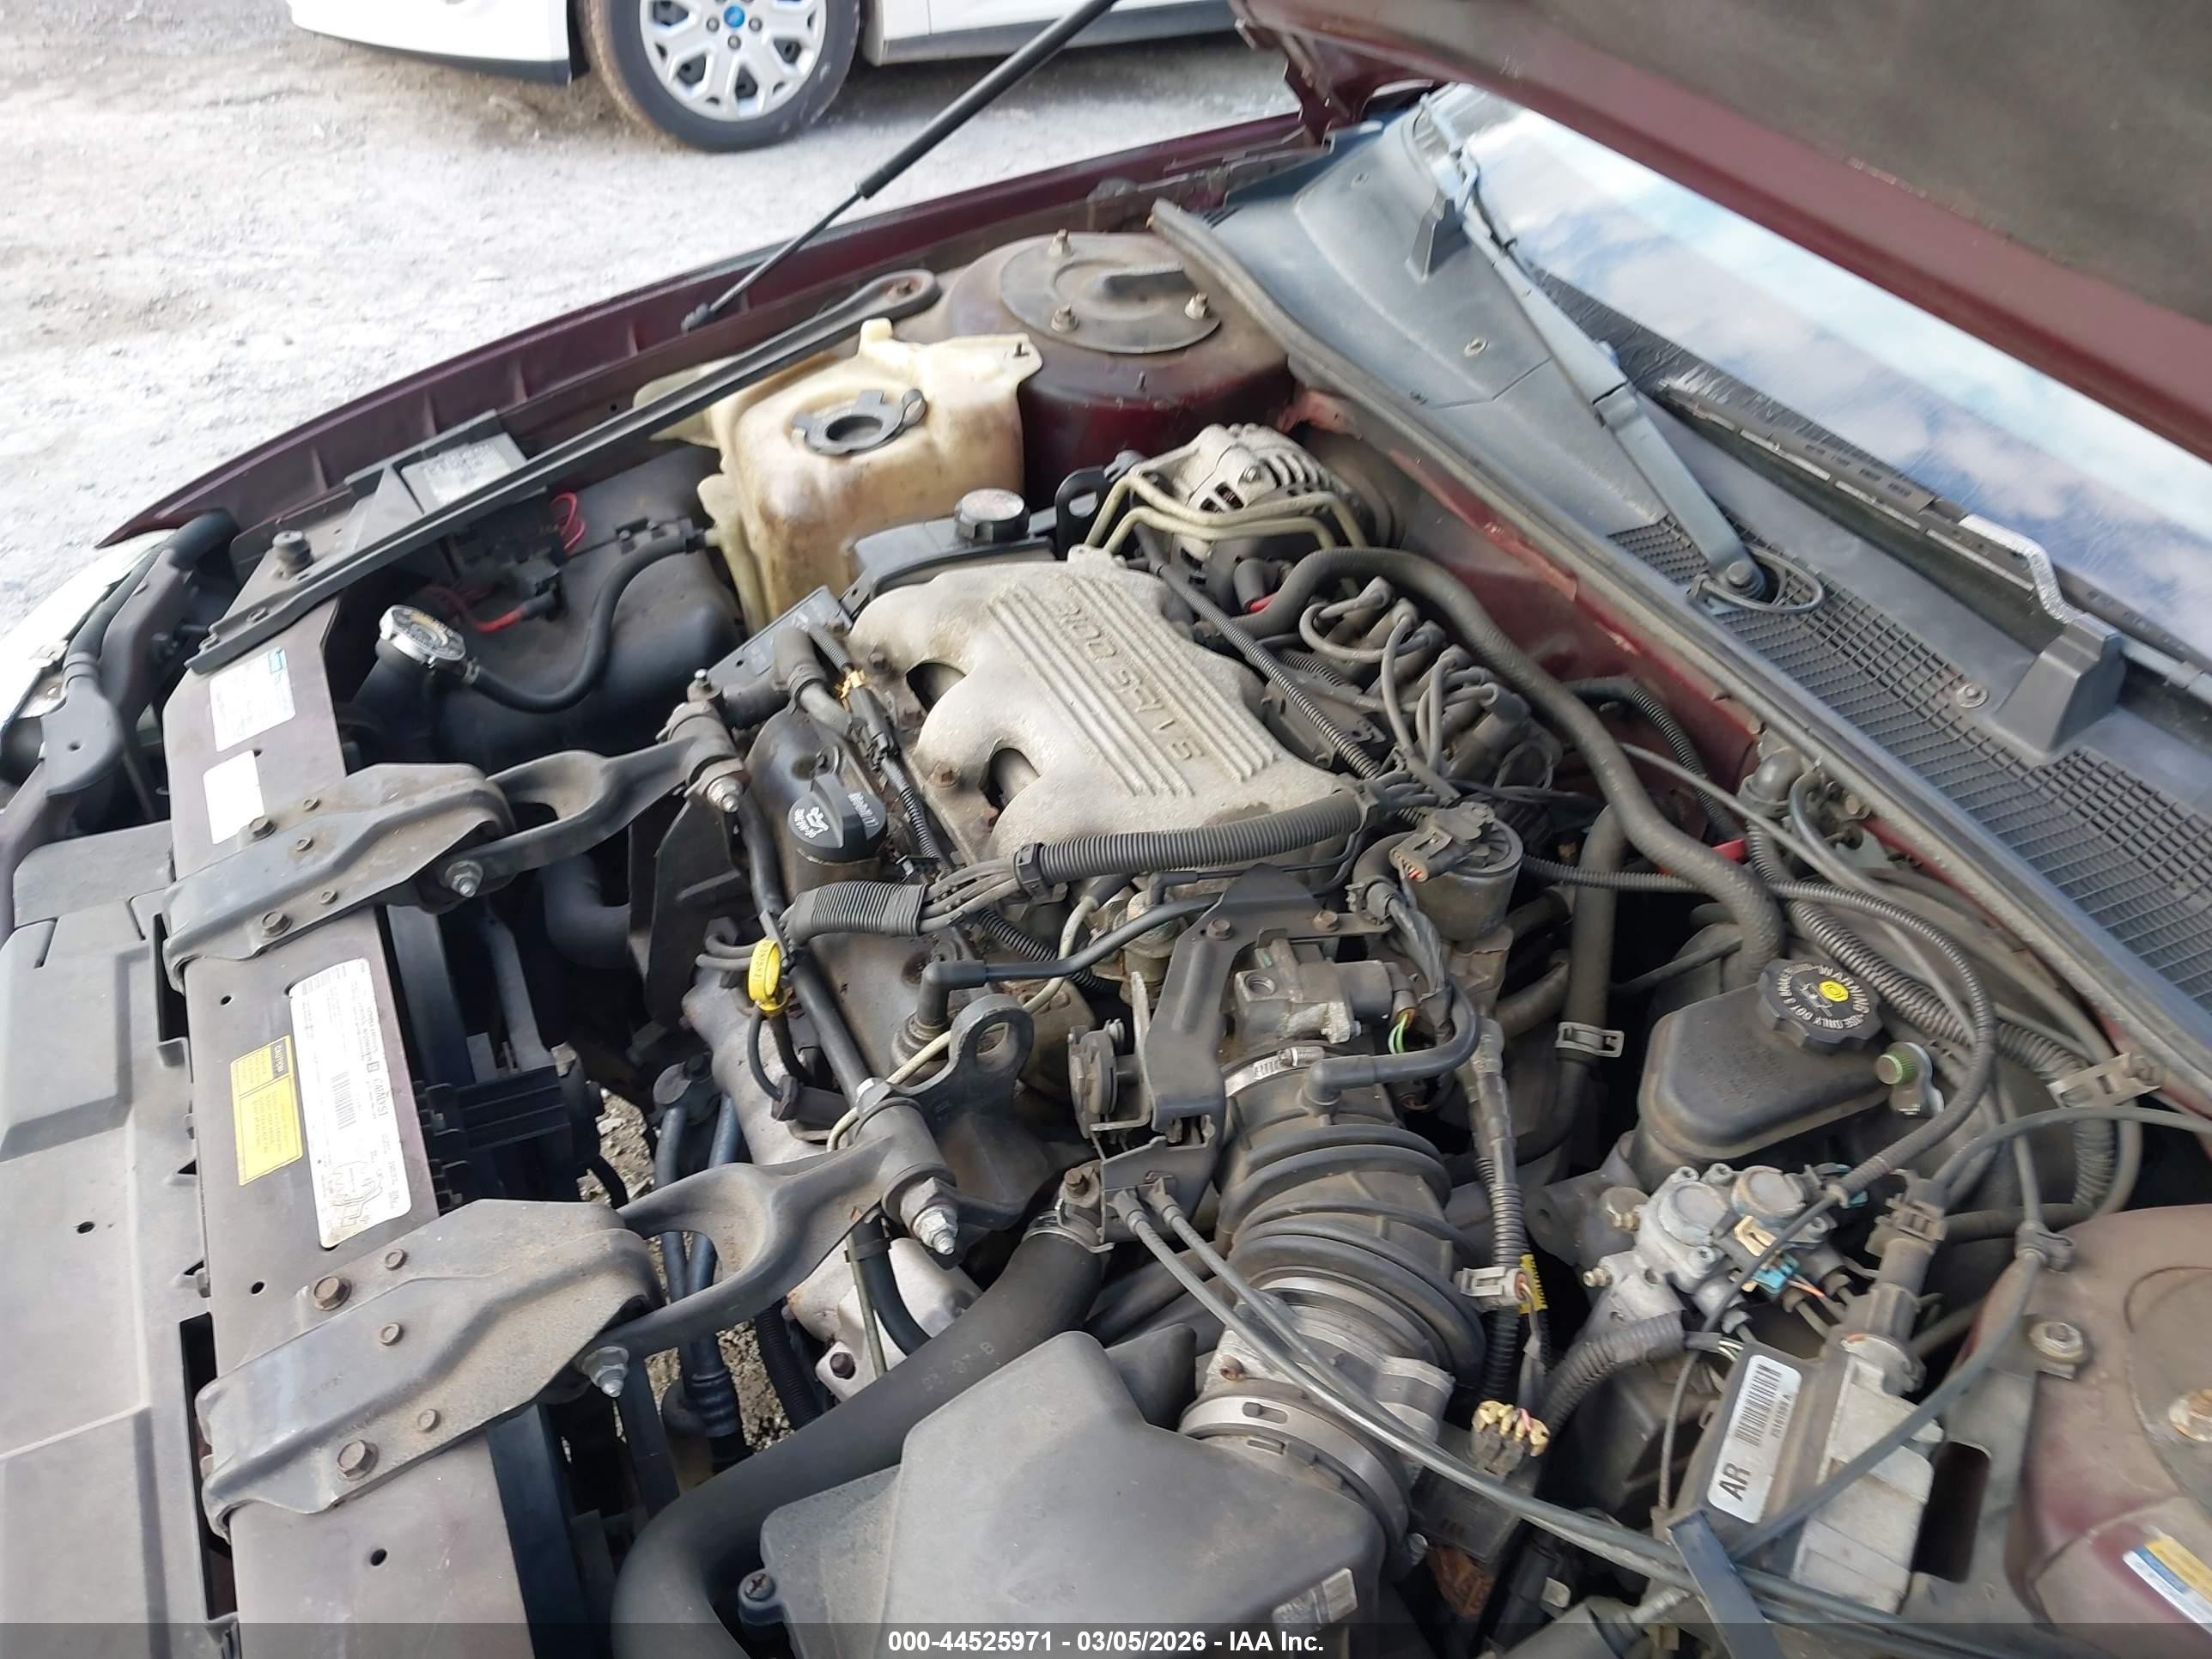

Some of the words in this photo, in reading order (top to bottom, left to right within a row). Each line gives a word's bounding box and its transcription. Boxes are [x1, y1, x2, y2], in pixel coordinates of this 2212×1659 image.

[1818, 965, 1870, 1014] WARNING
[374, 1078, 389, 1116] CATALYST
[1719, 1462, 1752, 1501] AR
